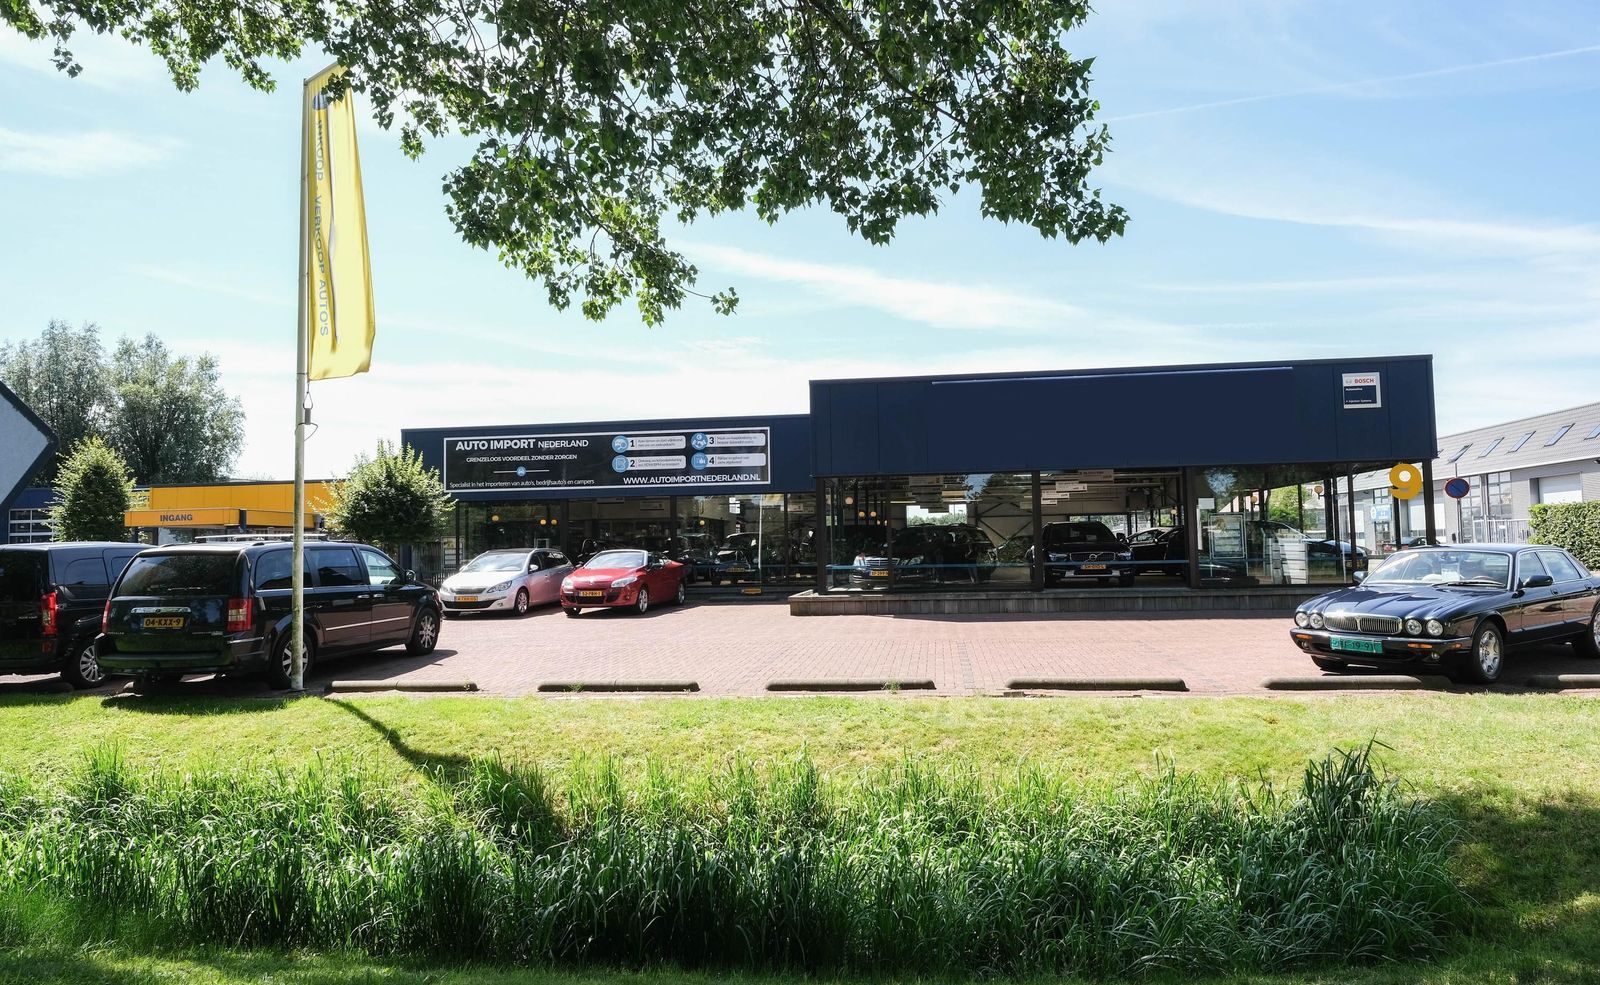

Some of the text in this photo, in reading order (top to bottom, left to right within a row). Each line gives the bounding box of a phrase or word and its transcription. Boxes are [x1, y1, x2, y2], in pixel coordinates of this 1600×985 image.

[314, 194, 325, 274] VERKOOP
[319, 279, 329, 337] AUTO'S
[455, 439, 589, 450] AUTO IMPORT NEDERLAND
[629, 439, 635, 447] 1
[709, 436, 715, 445] 3
[466, 455, 501, 463] GRENZELOOS
[629, 459, 635, 468] 2
[709, 456, 715, 465] 4
[623, 474, 760, 485] WWW.AUTOIMPORTNEDERLAND.NL
[1389, 463, 1422, 500] 9
[449, 481, 471, 489] Specialist
[485, 480, 511, 488] importeren
[160, 514, 193, 522] INGANG
[145, 618, 181, 626] 04-KXX-9
